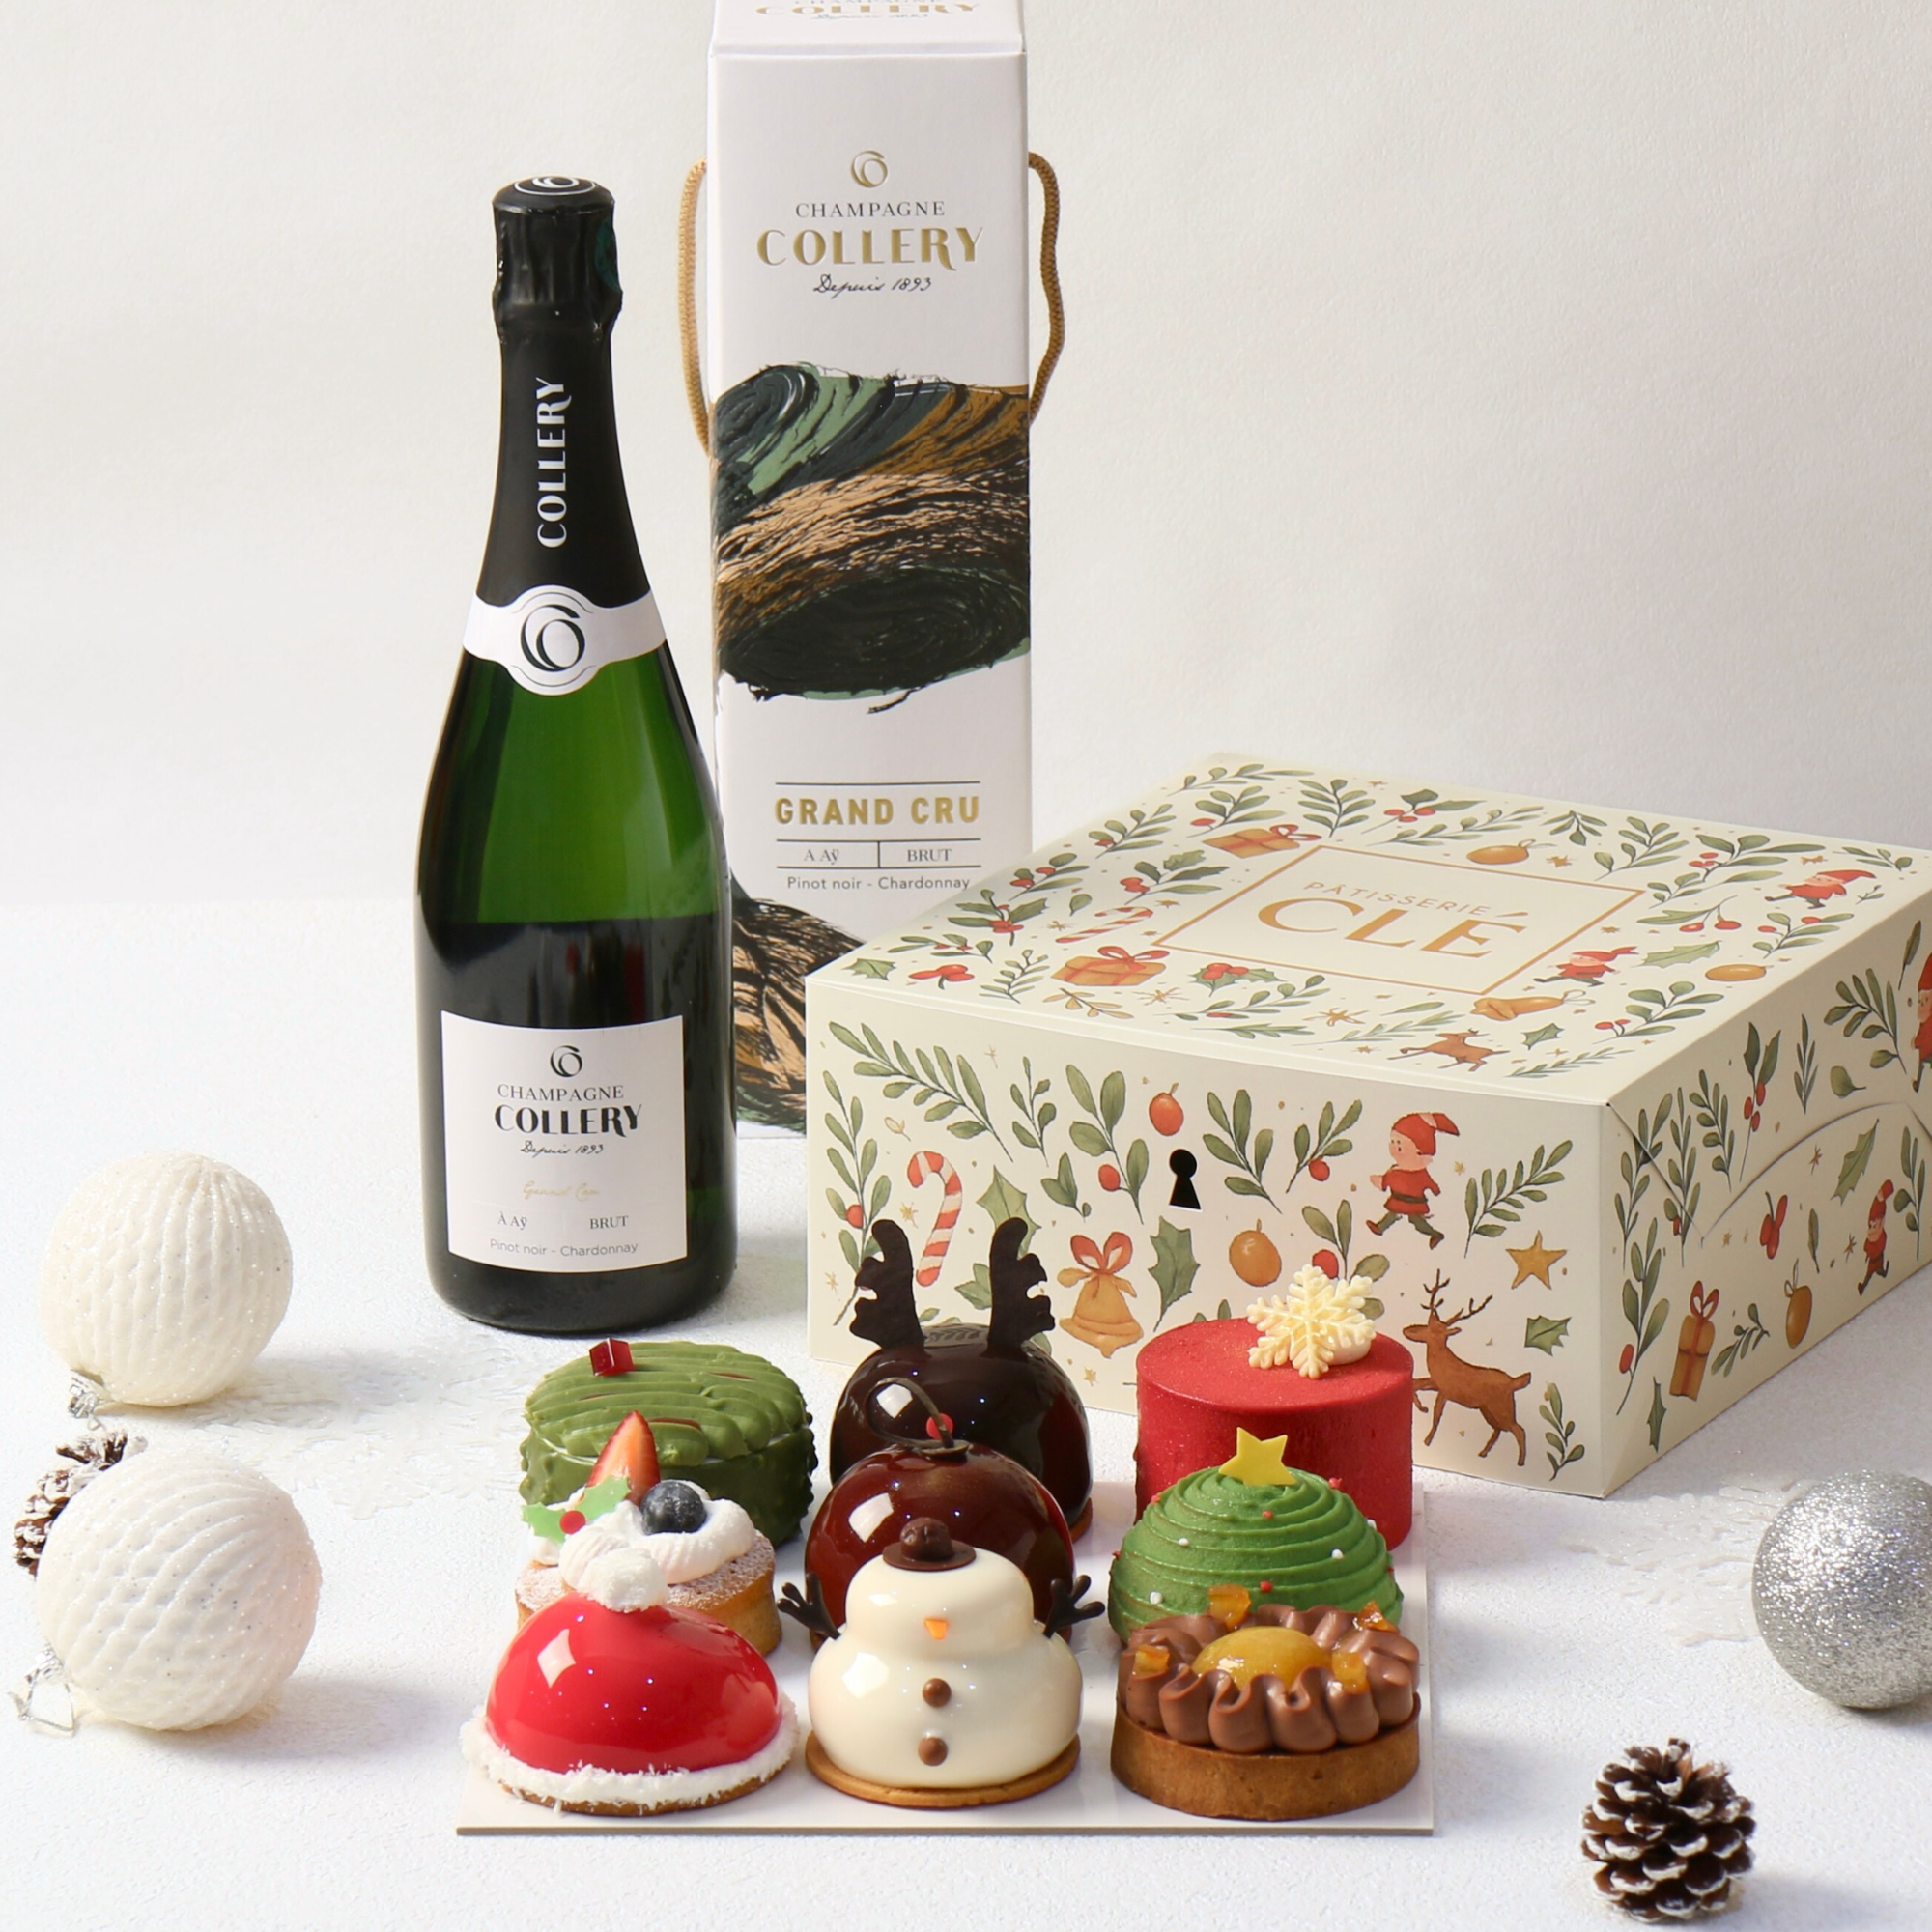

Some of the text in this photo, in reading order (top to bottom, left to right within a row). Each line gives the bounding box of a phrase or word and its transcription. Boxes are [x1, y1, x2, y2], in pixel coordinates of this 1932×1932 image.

[795, 201, 946, 218] CHAMPAGNE
[756, 226, 983, 271] COLLERY
[812, 273, 932, 299] Depuis 1893
[535, 376, 573, 548] COLLERY
[775, 796, 980, 825] GRAND CRU
[906, 848, 952, 863] BRUT
[787, 876, 827, 890] Pinot
[832, 876, 862, 890] noir
[878, 874, 970, 891] Chardonnay
[1302, 881, 1492, 917] PÂTISSERIE
[1257, 896, 1529, 959] CLÉ
[497, 1083, 624, 1102] CHAMPAGNE
[494, 1103, 642, 1138] COLLERY
[520, 1140, 605, 1158] Depuis 1893
[589, 1215, 629, 1230] BRUT
[490, 1238, 520, 1254] Pinot
[523, 1243, 547, 1256] noir
[560, 1242, 639, 1257] Chardonnay
